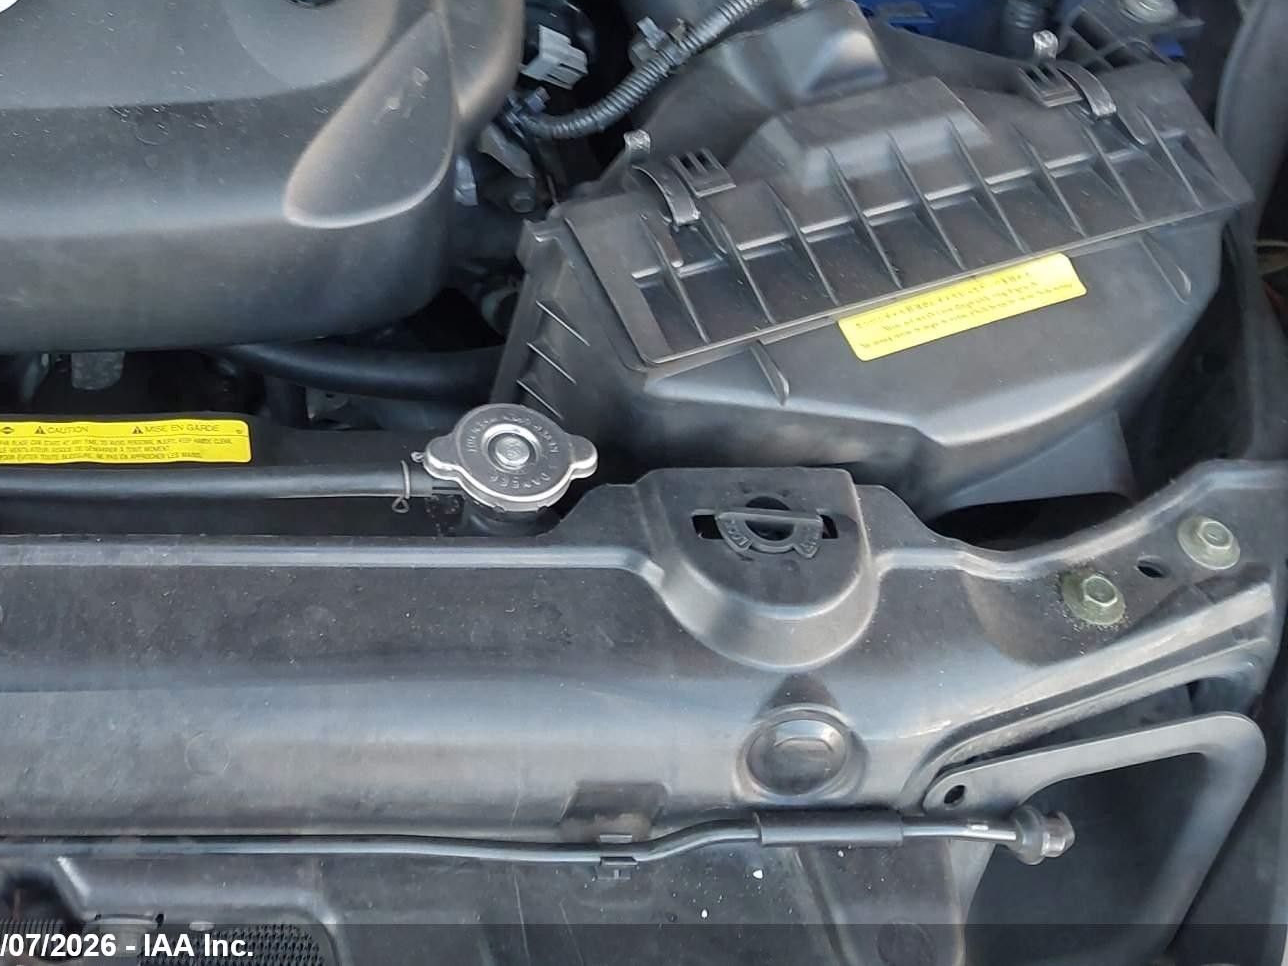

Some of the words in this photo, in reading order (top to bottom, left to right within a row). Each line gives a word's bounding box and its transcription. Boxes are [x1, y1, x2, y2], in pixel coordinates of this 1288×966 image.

[47, 425, 89, 434] CAUTION
[144, 424, 169, 433] MISE
[171, 424, 185, 432] EN
[186, 424, 220, 432] GARDE
